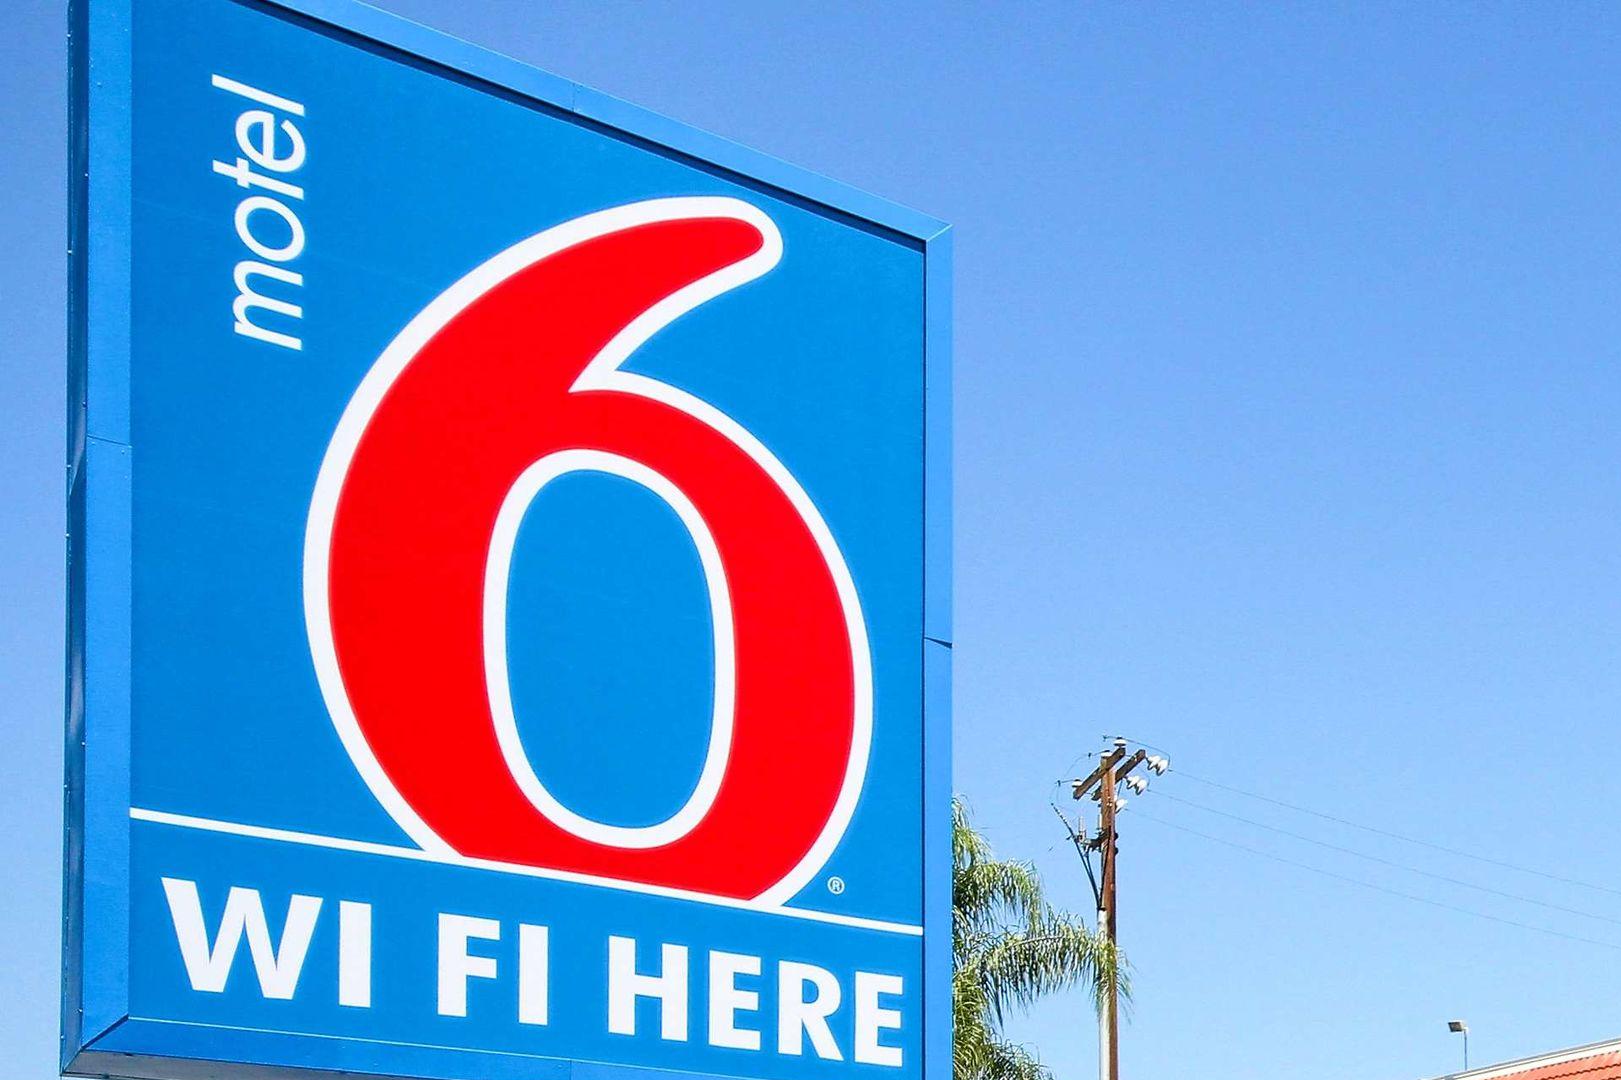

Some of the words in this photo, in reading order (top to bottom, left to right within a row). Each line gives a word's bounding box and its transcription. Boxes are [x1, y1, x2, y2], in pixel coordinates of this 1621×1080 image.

[211, 74, 307, 350] motel
[303, 196, 874, 907] 6
[161, 877, 372, 1008] WI
[437, 912, 549, 1026] FI
[608, 935, 903, 1067] HERE
